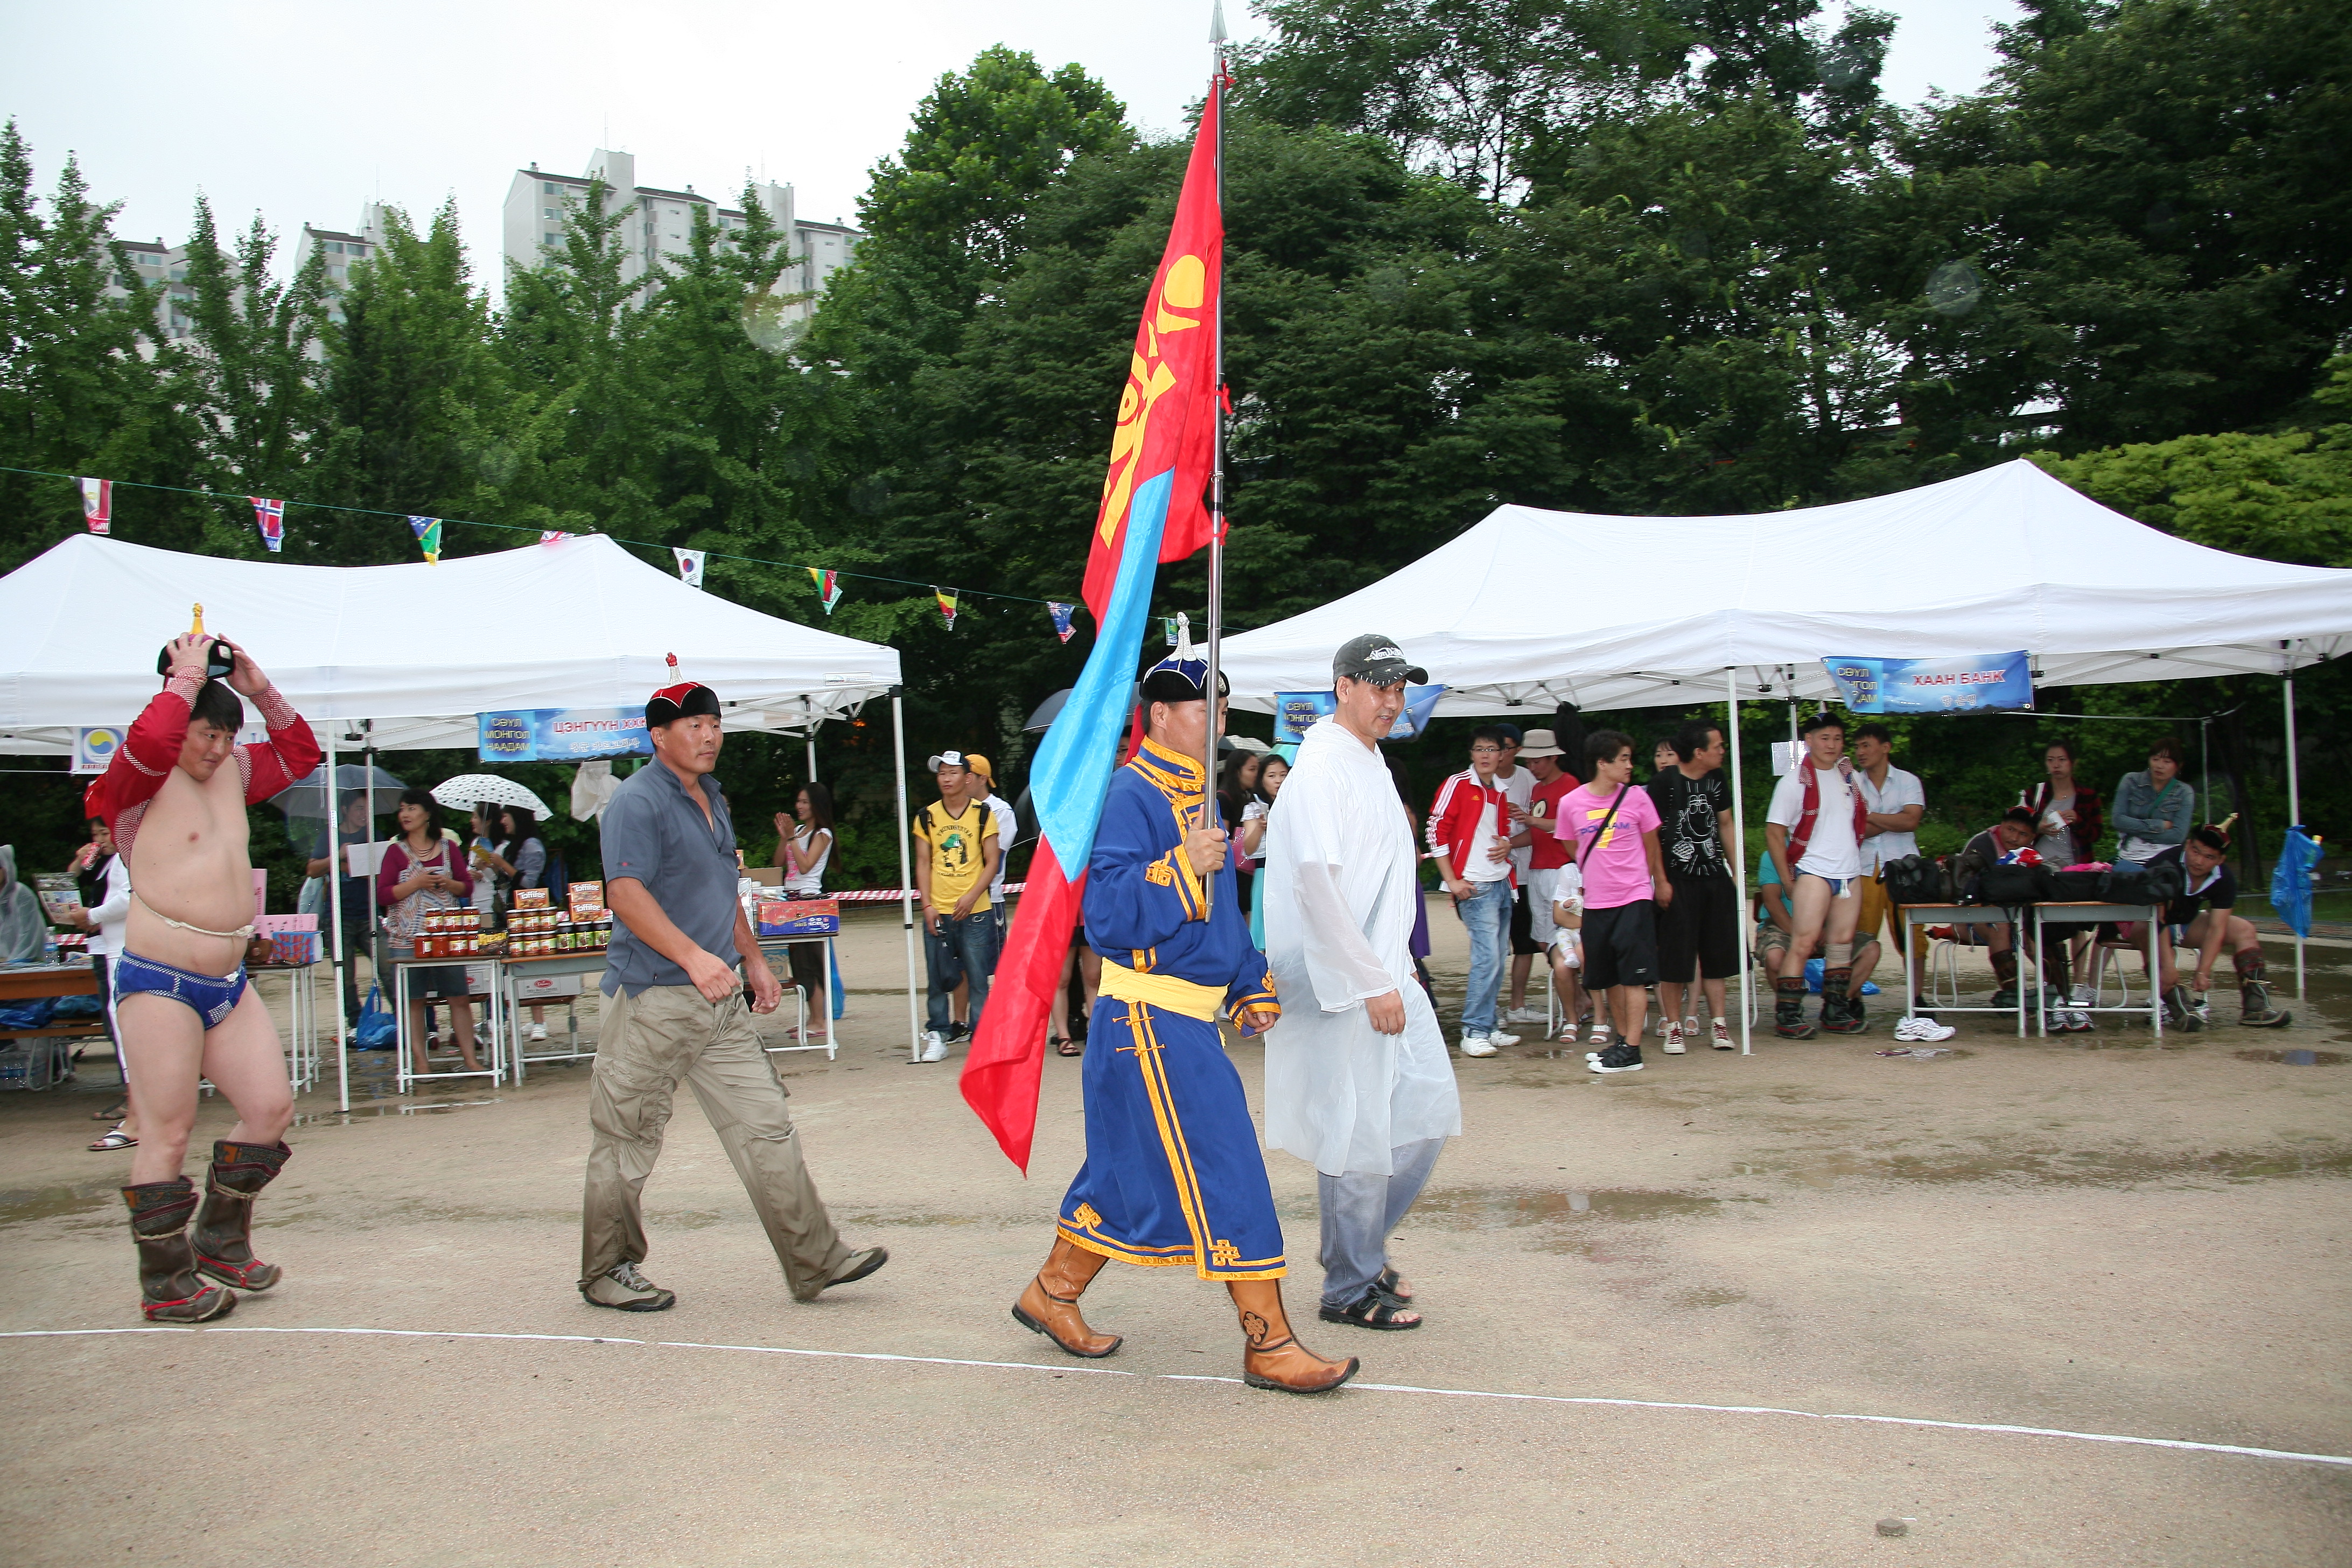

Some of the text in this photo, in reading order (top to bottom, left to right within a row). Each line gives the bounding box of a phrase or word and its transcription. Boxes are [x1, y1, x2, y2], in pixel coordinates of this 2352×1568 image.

[1912, 669, 2006, 686] ХААН БАНК
[484, 730, 530, 739] МОНГОЛ
[485, 743, 530, 752] НААДАМ
